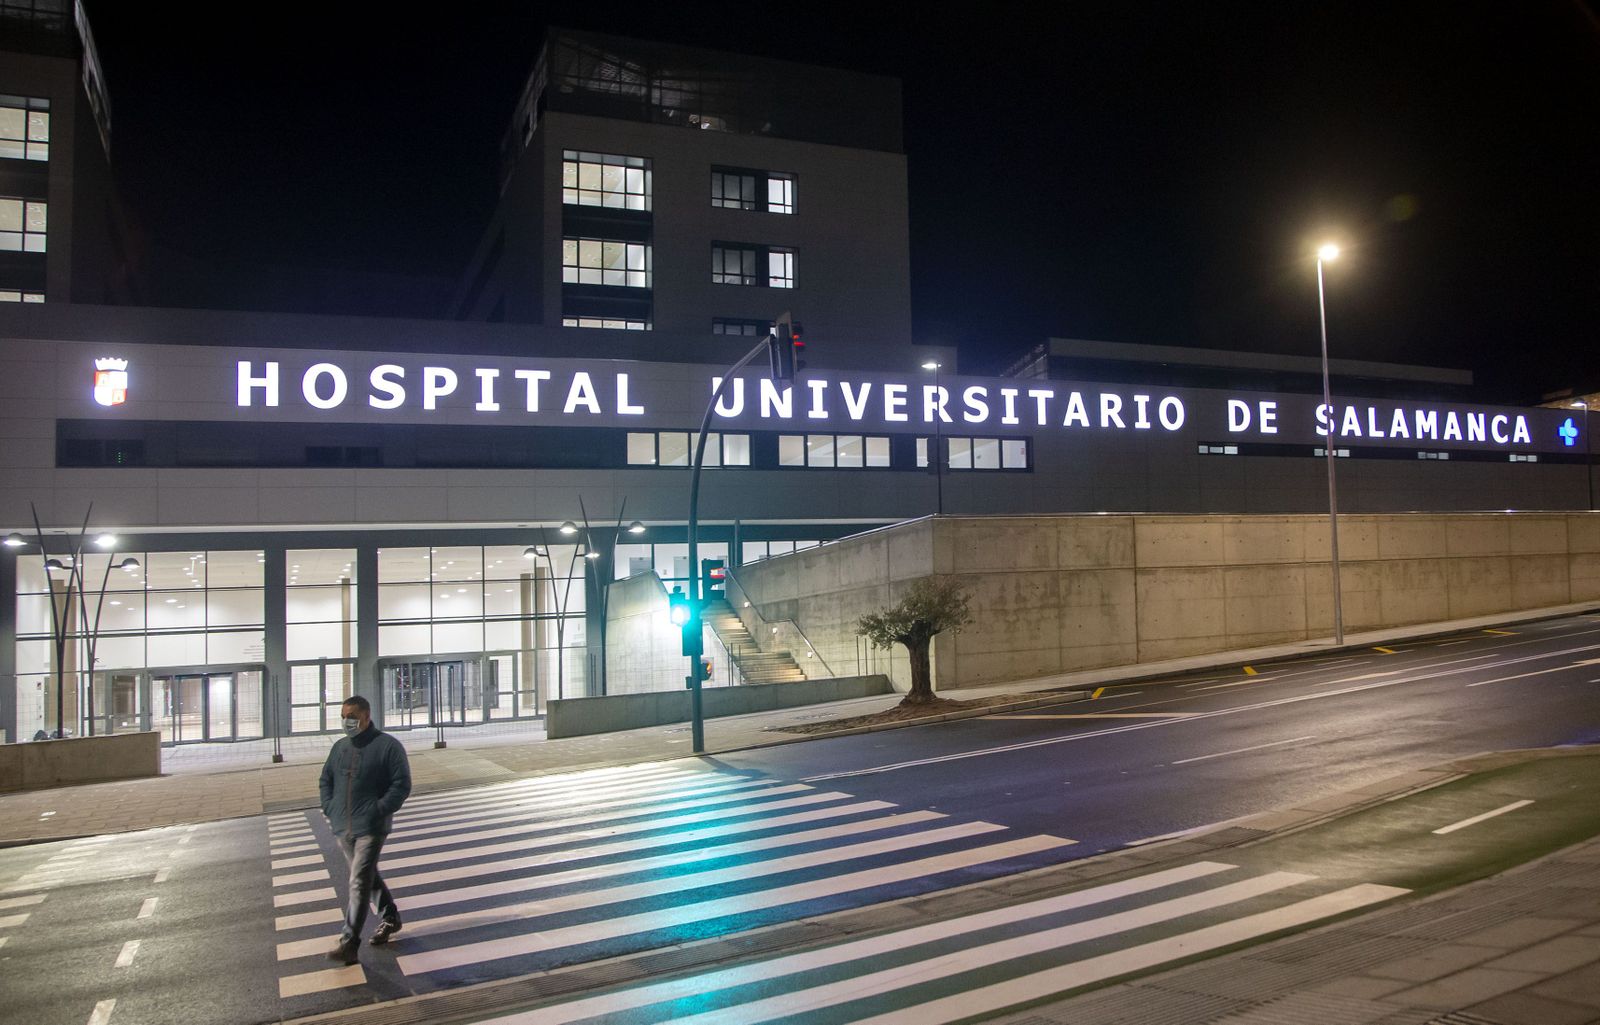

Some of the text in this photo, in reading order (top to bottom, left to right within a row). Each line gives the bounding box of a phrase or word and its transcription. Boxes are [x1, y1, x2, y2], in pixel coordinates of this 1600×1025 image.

[237, 361, 1531, 444] HOSPITAL UNIVERSITARIO DE SALAMANCA
